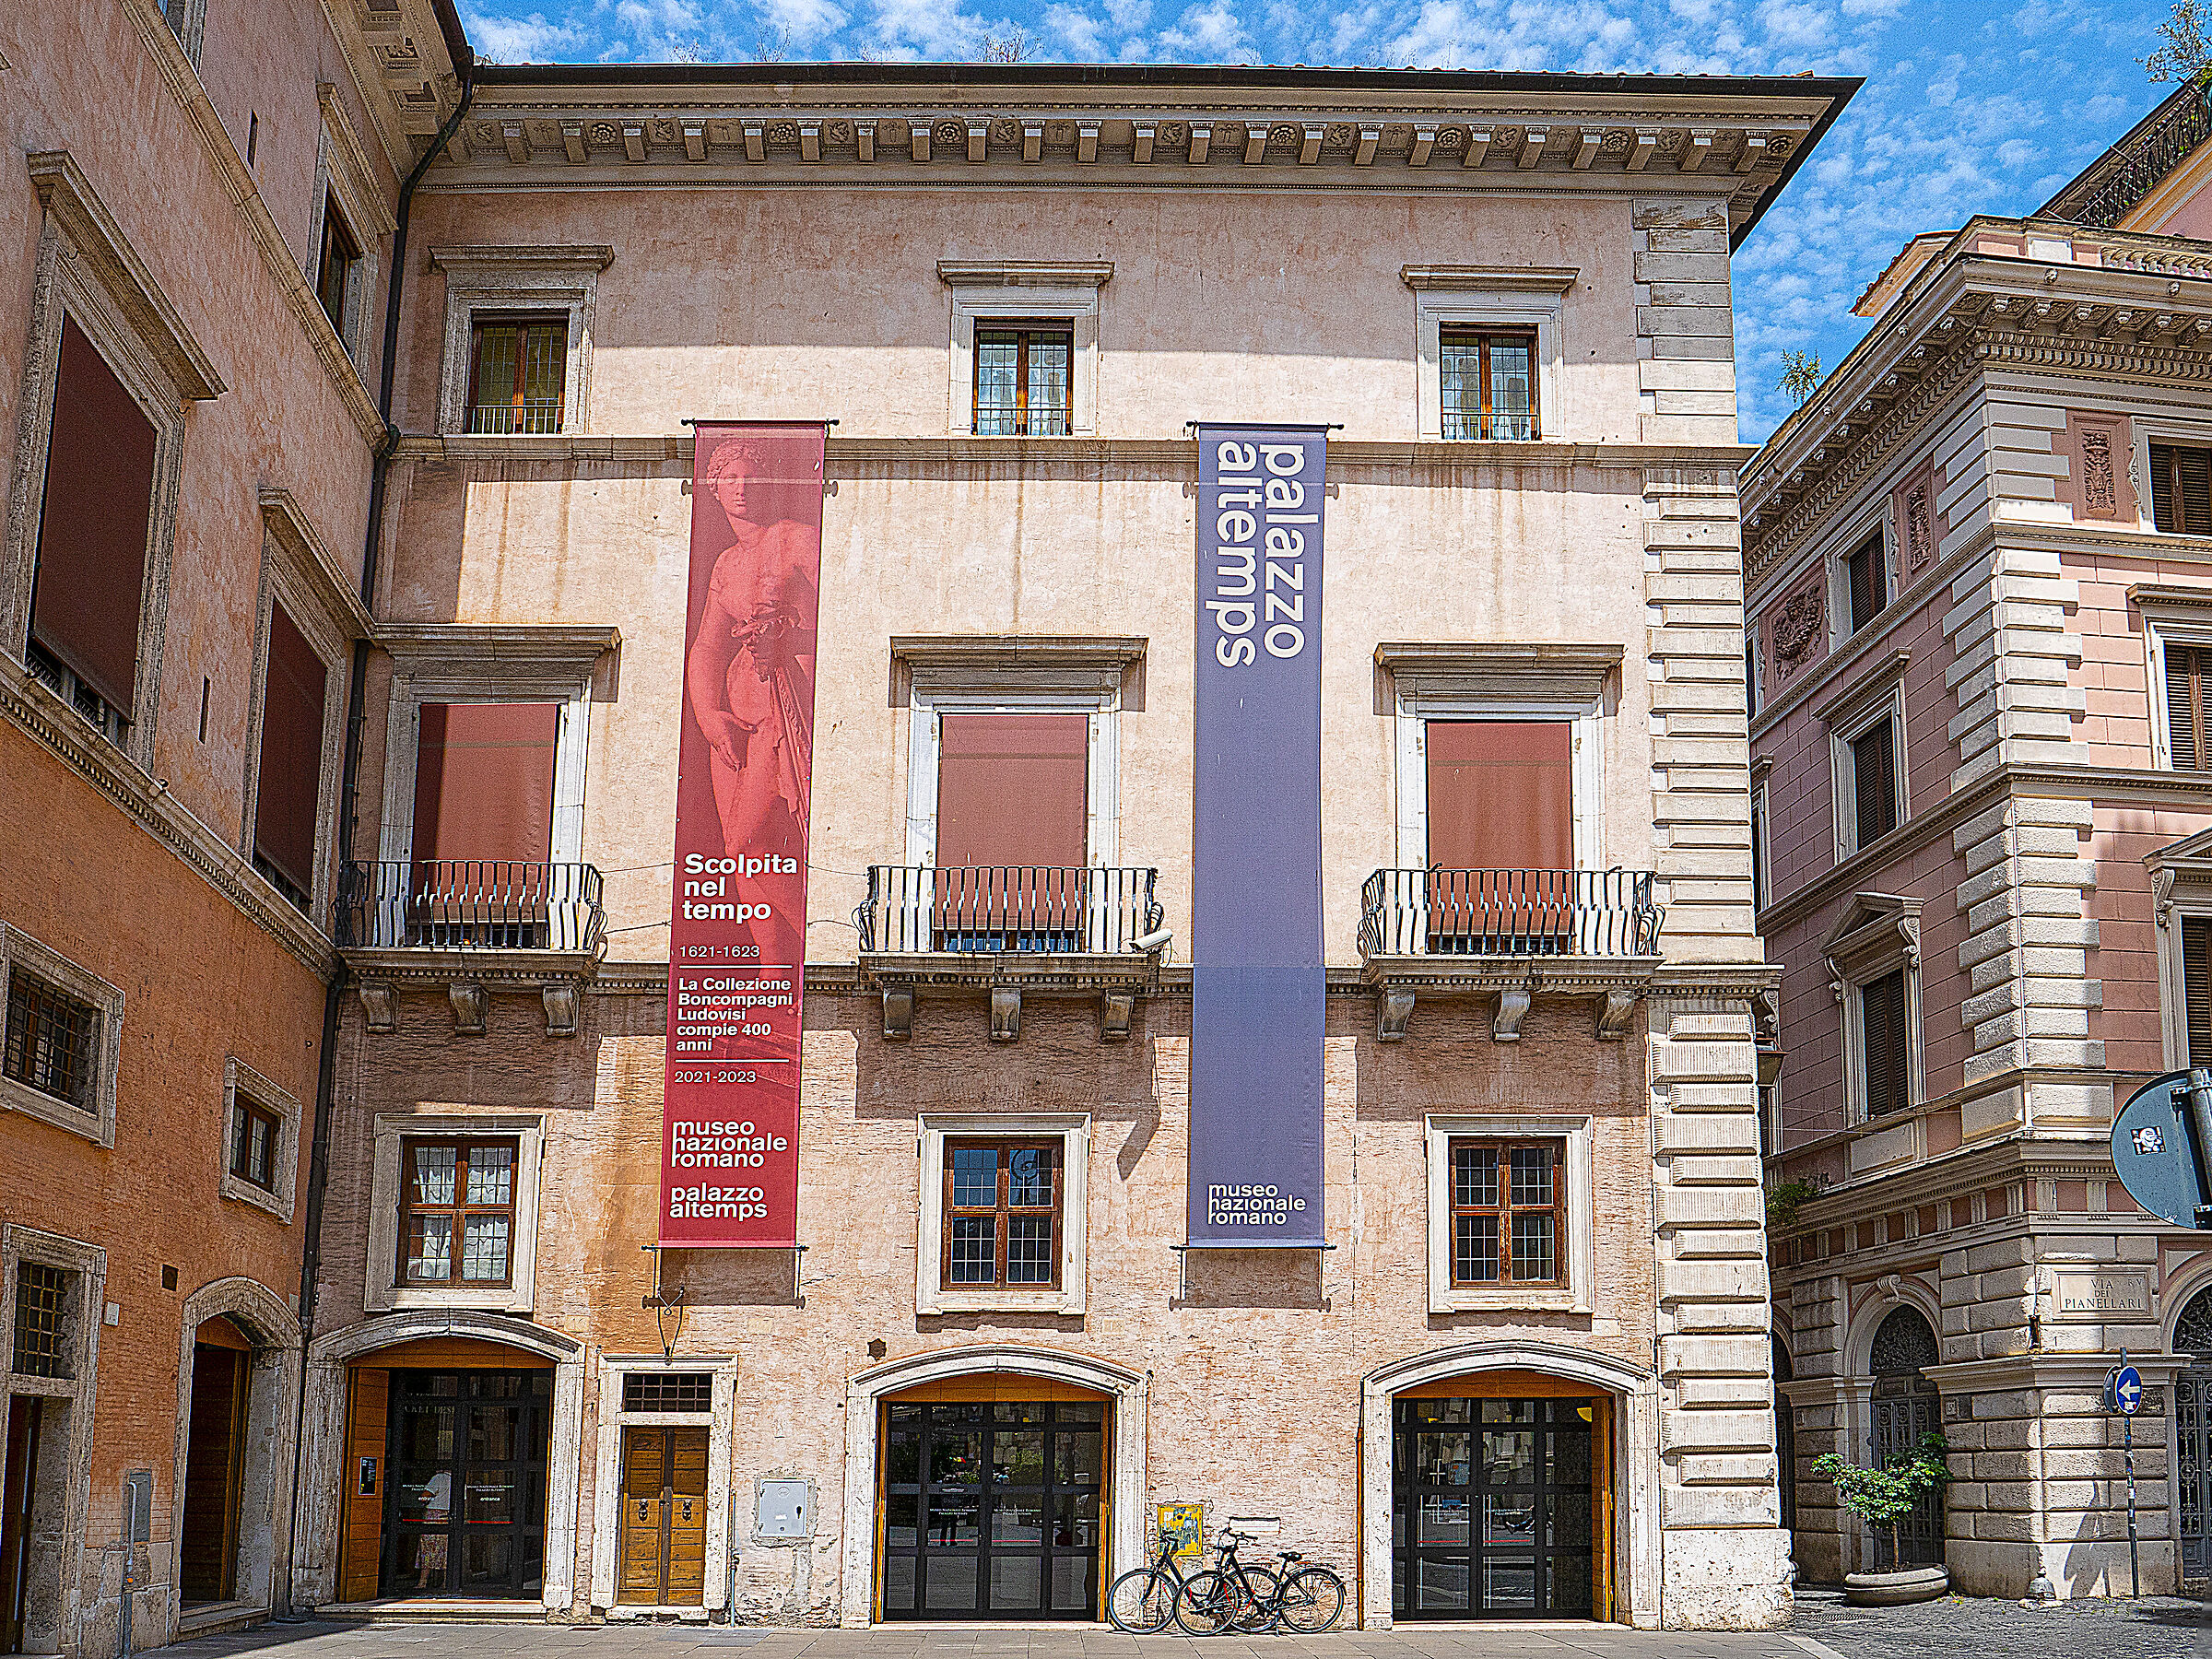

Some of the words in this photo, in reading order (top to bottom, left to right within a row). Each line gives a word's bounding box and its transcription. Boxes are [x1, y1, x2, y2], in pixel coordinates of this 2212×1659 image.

[1205, 441, 1264, 668] altemps
[1259, 443, 1319, 659] palazzo
[683, 853, 798, 878] Scolpita
[683, 877, 726, 898] nel
[681, 900, 772, 924] tempo
[679, 945, 761, 959] 1621-1623
[678, 977, 700, 991] La
[702, 977, 792, 992] Collezione
[678, 993, 794, 1009] Boncompagni
[677, 1007, 747, 1021] Ludovisi
[676, 1023, 738, 1040] compie
[741, 1023, 771, 1037] 400
[676, 1038, 713, 1052] anni
[674, 1071, 757, 1084] 2021-2023
[672, 1120, 756, 1136] museo
[672, 1133, 789, 1152] nazionale
[671, 1151, 766, 1169] romano
[670, 1182, 764, 1204] palazzo
[1208, 1183, 1278, 1197] museo
[1208, 1194, 1307, 1211] nazionale
[669, 1201, 769, 1222] altemps
[1207, 1210, 1288, 1225] romano
[2090, 1279, 2114, 1289] VIA
[2065, 1299, 2142, 1309] PIANELLARI
